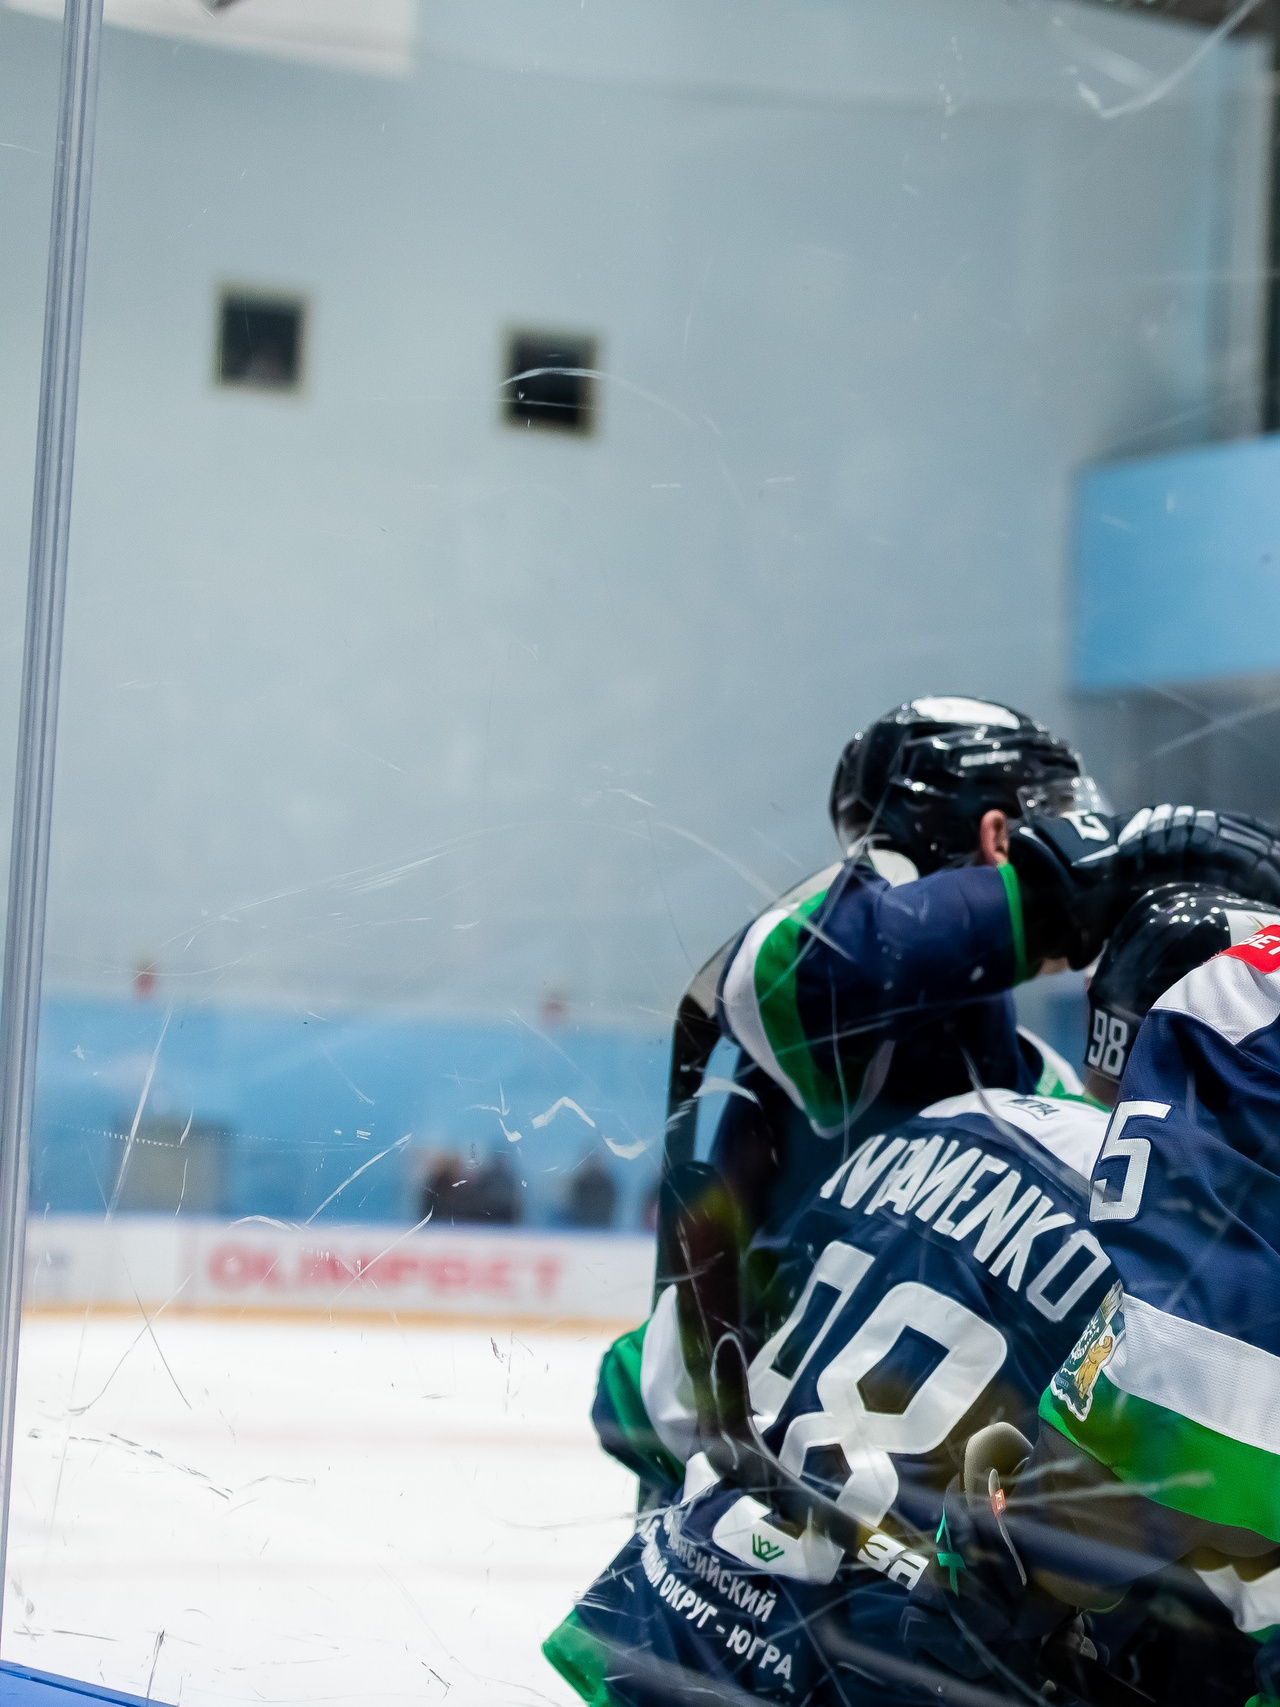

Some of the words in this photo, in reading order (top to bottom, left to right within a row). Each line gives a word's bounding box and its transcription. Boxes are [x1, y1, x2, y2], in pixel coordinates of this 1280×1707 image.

[1088, 1008, 1128, 1077] 98
[659, 1573, 718, 1629] ОКРУГ
[726, 1624, 792, 1680] ЮГРА
